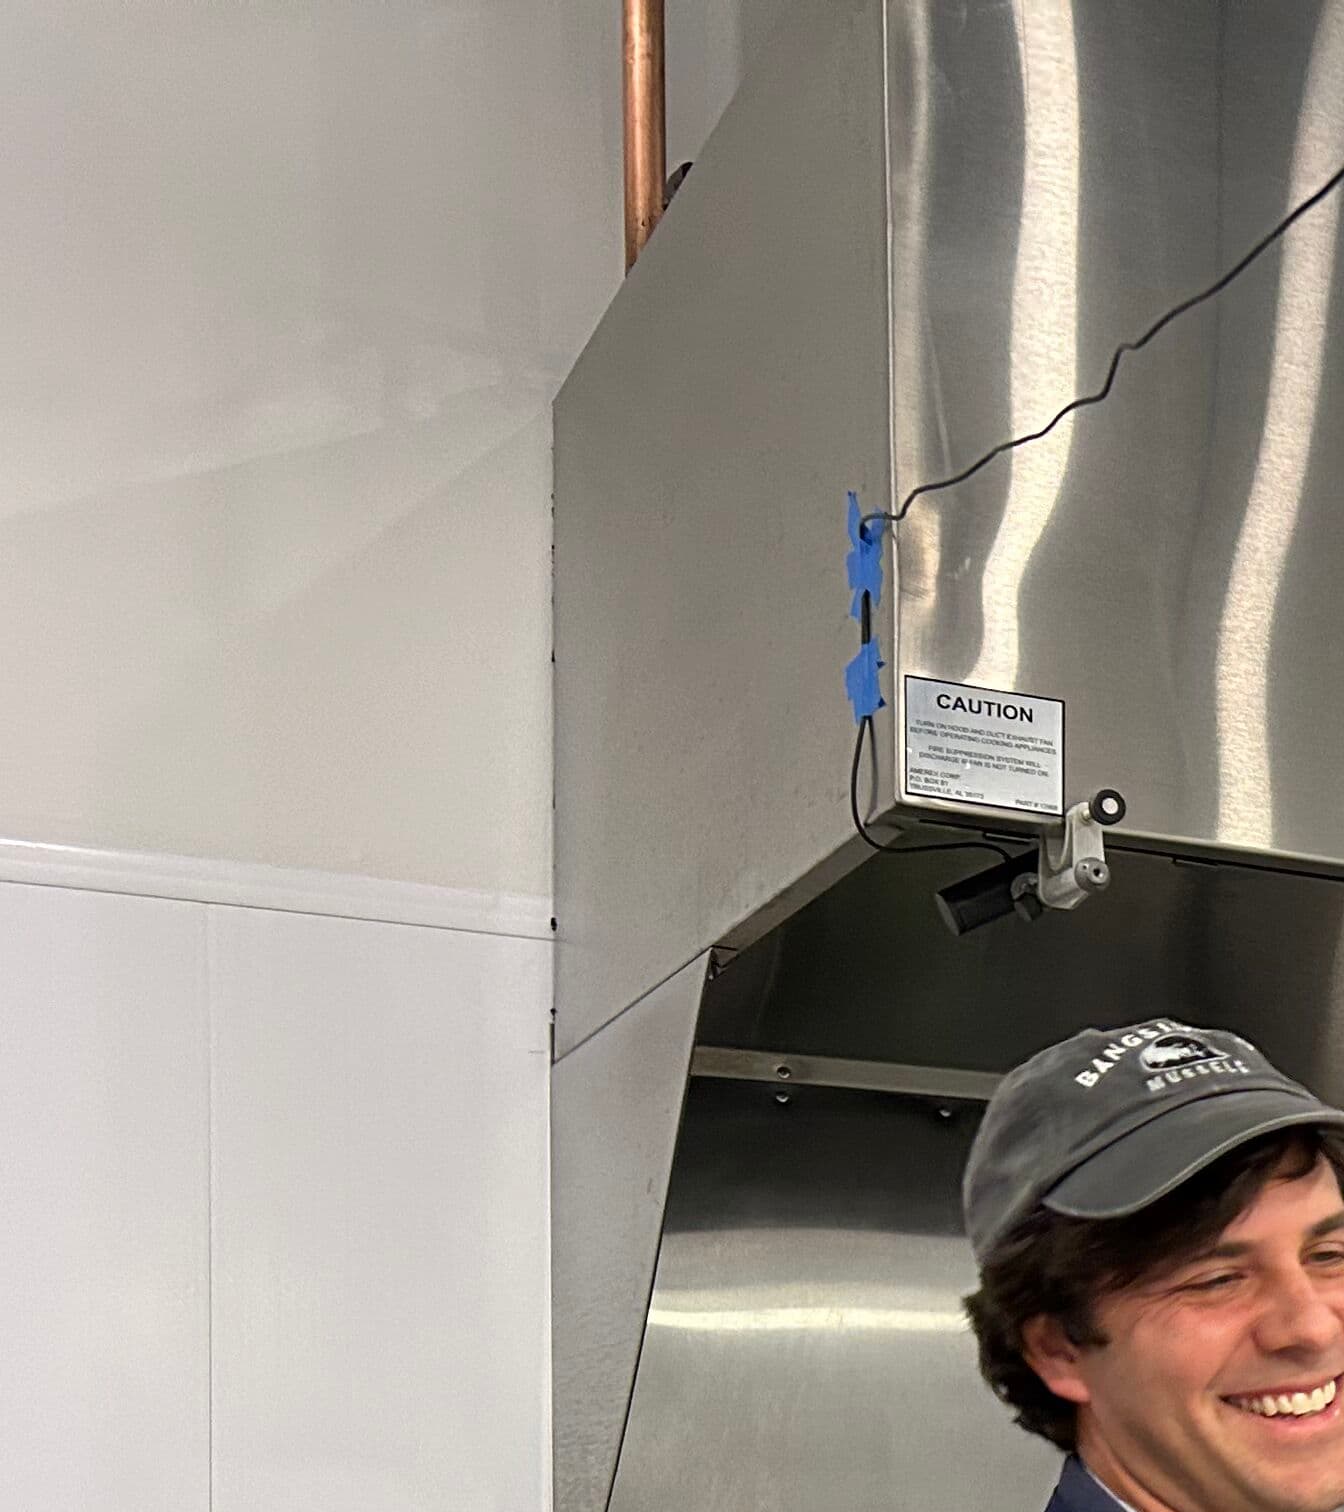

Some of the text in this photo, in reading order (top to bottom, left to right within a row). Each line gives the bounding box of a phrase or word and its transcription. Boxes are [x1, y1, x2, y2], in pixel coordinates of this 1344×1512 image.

[937, 693, 1033, 723] CAUTION
[910, 726, 1056, 755] BEFORE OPERATING COOKING APPLIANCES
[936, 721, 947, 730] ON
[949, 723, 969, 733] HOOD
[970, 727, 985, 736] AND
[919, 751, 960, 764] DISCHARGE
[968, 759, 983, 767] FAN
[992, 762, 1007, 770] NOT
[1008, 765, 1036, 775] TURNED
[928, 745, 1041, 768] FIRE SUPPRESSION SYSTEM WILL
[1074, 1026, 1160, 1088] BANGS
[1146, 1059, 1249, 1092] MUSSELS
